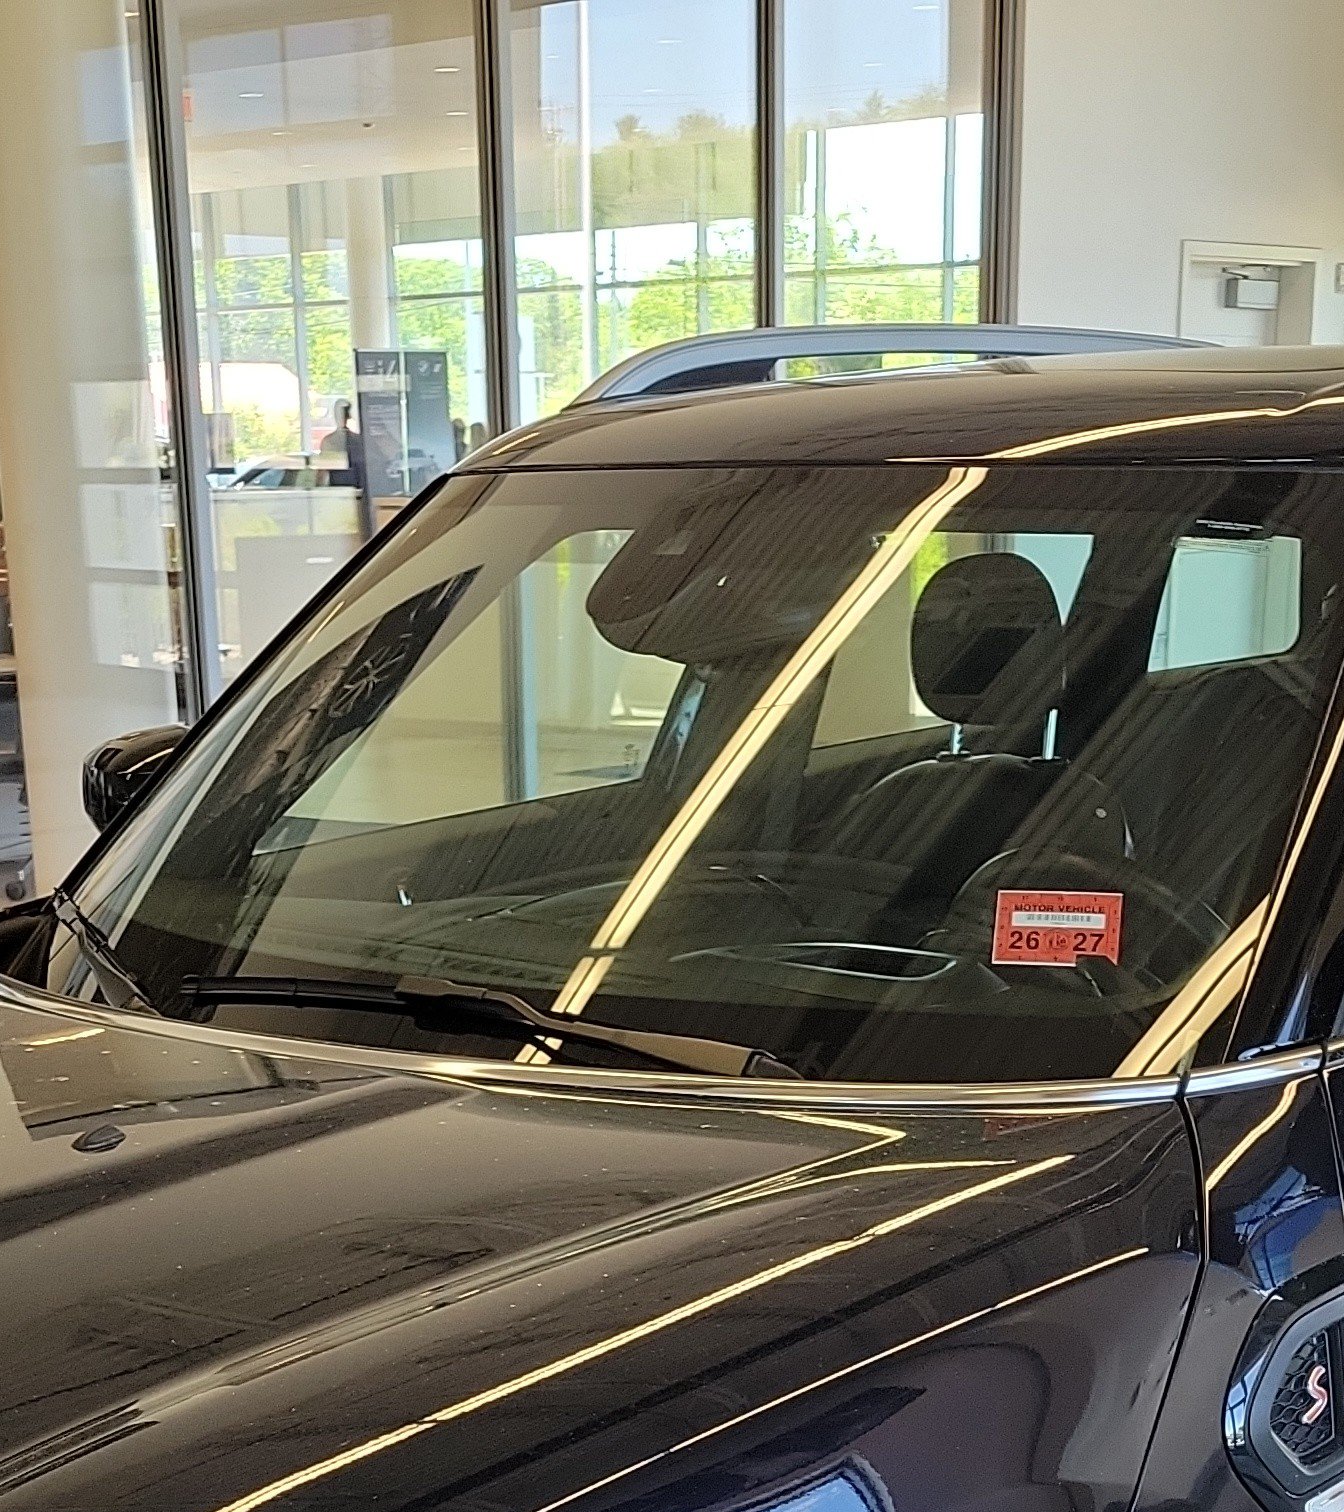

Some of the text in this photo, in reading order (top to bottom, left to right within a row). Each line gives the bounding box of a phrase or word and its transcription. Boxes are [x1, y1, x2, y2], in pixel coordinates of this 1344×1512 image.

[1014, 903, 1105, 914] MOTOR VEHICLE
[1008, 930, 1040, 950] 26
[1072, 932, 1105, 952] 27
[1301, 1365, 1328, 1424] S
